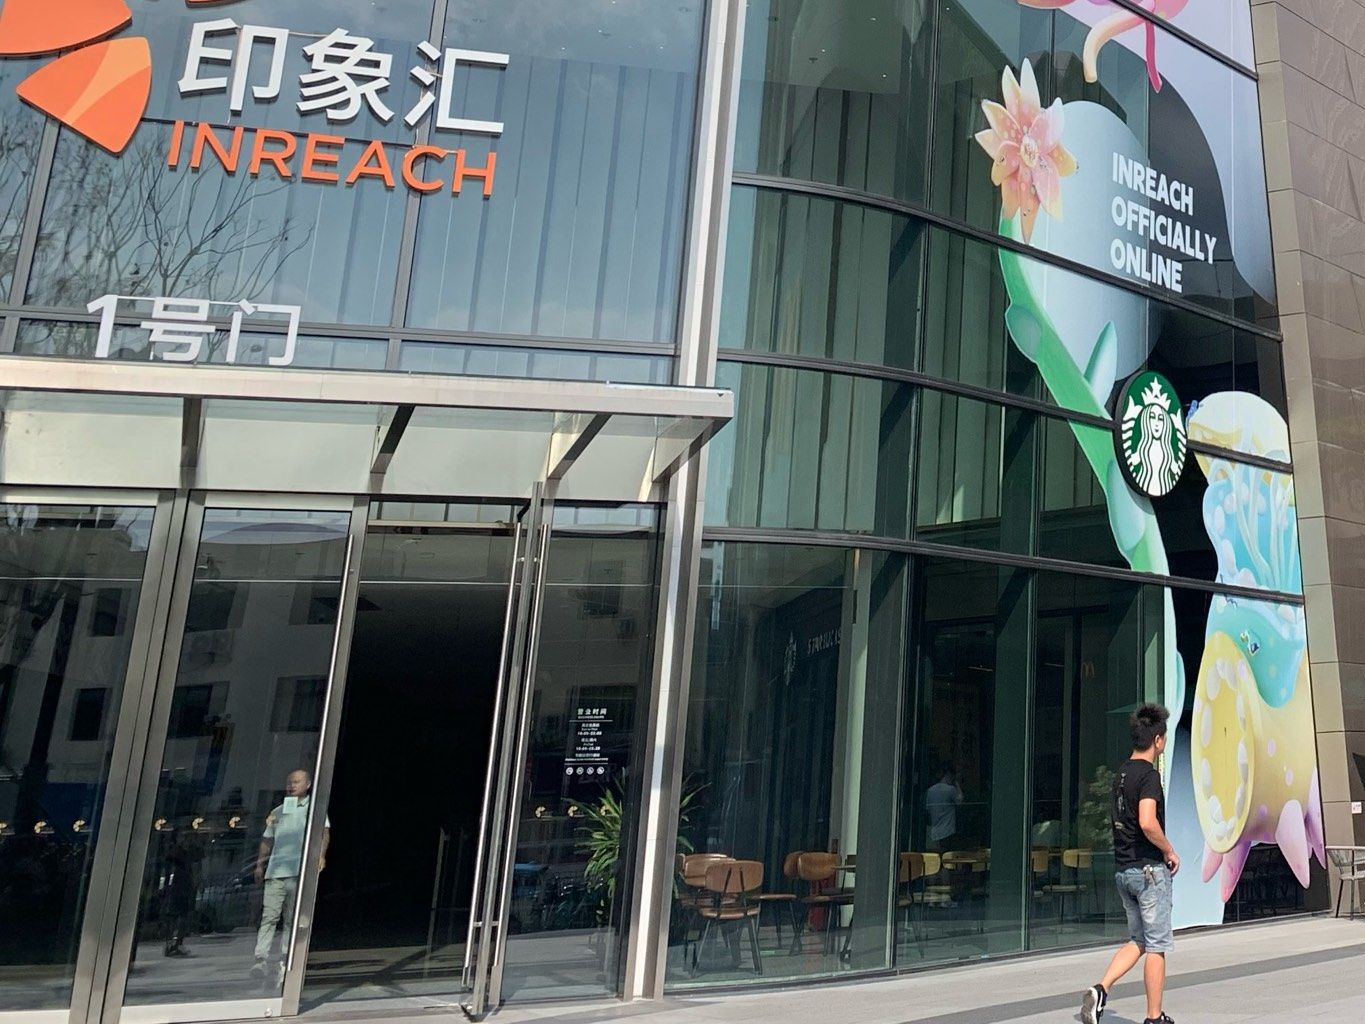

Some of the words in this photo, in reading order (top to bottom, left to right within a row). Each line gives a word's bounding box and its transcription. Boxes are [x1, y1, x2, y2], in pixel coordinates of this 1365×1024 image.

[177, 18, 510, 134] 印象汇
[168, 121, 497, 197] INREACH
[1112, 152, 1194, 216] INREACH
[1111, 196, 1217, 265] OFFICIALLY
[1111, 239, 1182, 293] ONLINE
[86, 294, 302, 367] 1号门
